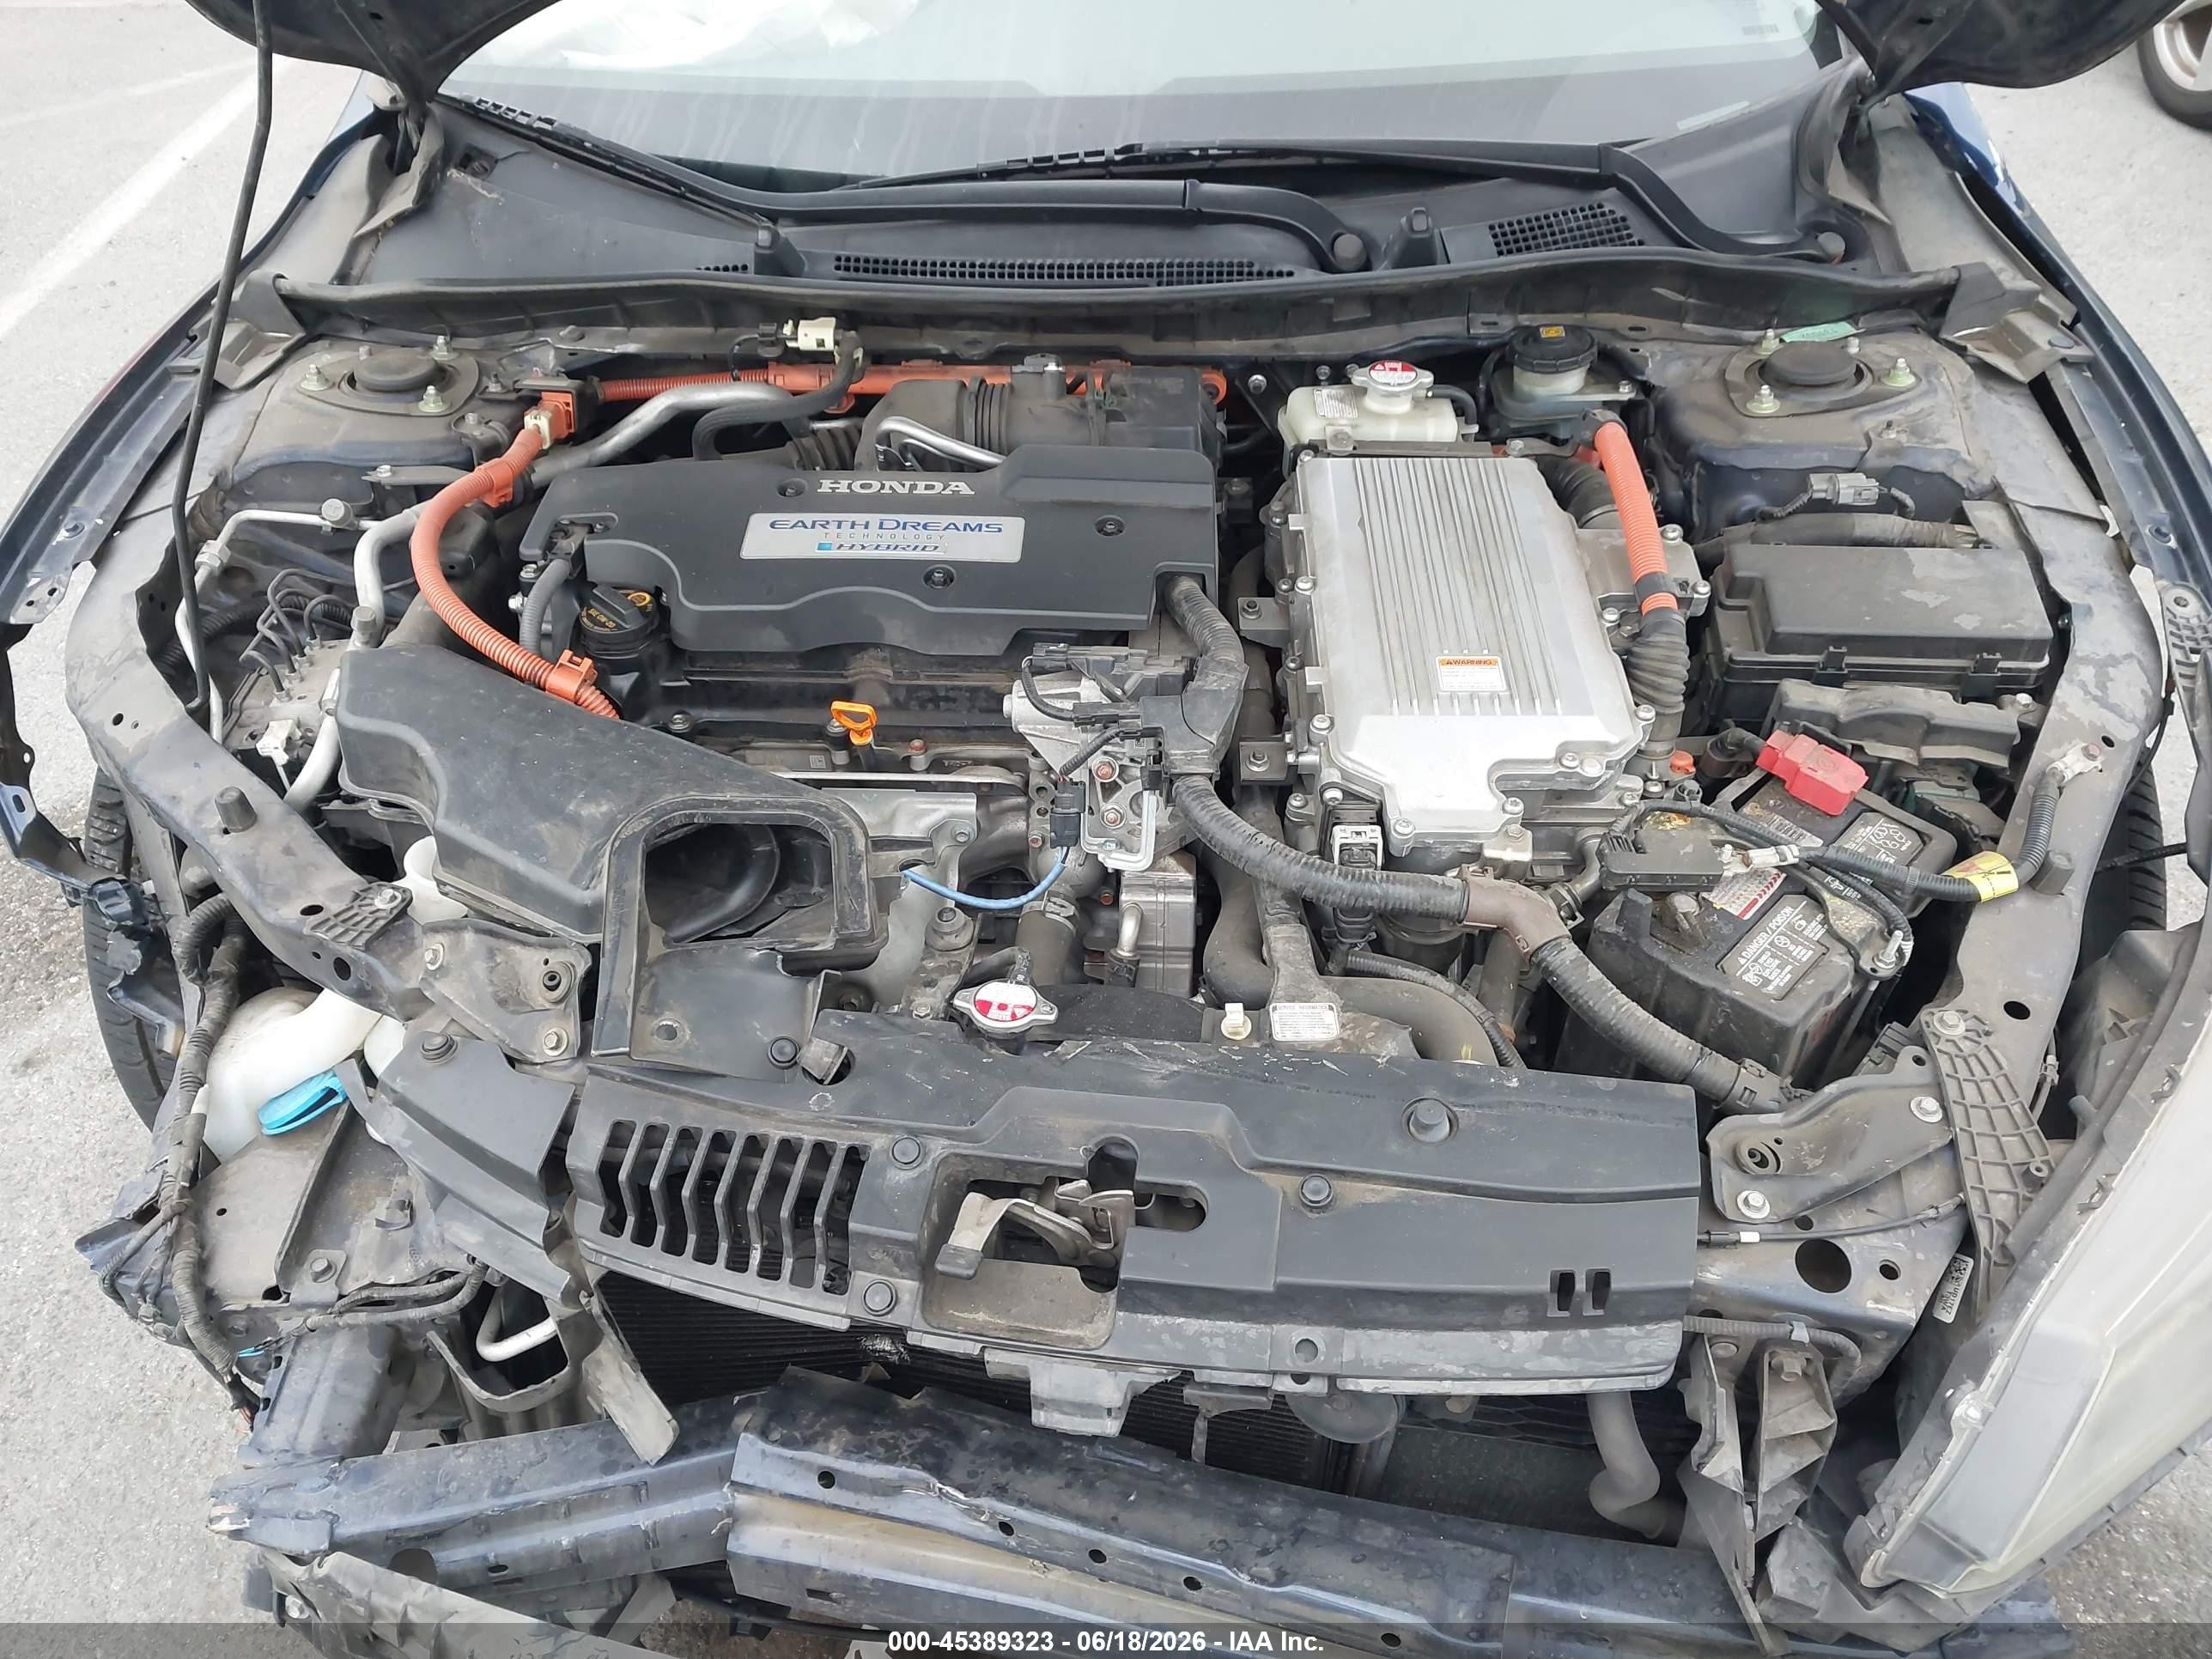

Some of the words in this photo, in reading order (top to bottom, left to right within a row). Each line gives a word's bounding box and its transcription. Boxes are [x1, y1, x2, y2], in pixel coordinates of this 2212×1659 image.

[817, 479, 975, 495] HONDA
[769, 519, 870, 531] EARTH
[878, 519, 1003, 533] DREAMS
[824, 532, 945, 541] TECHNOLOGY
[836, 543, 939, 551] HYBRID
[1741, 932, 1770, 959] DANGER
[1769, 906, 1795, 929] POISON
